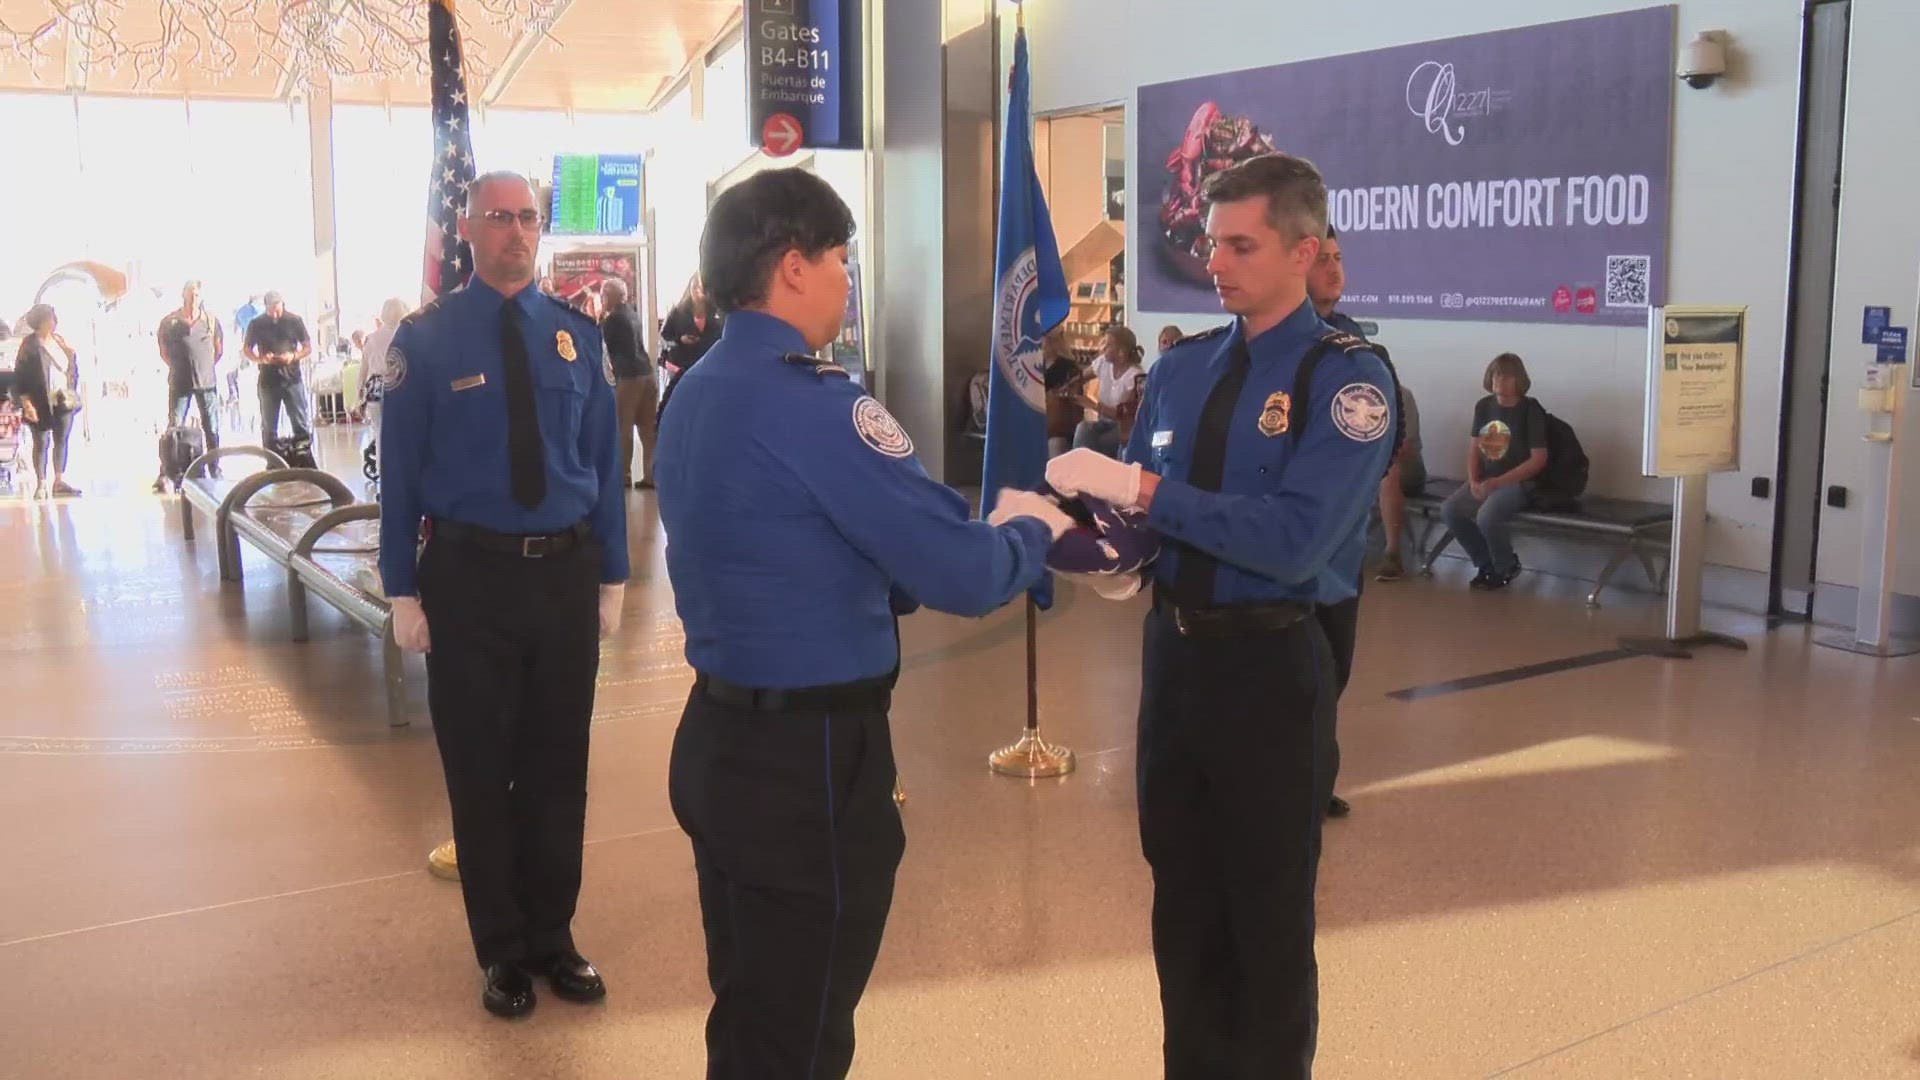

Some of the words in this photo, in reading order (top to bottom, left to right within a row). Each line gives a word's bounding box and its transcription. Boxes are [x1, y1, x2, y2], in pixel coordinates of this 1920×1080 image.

[761, 20, 820, 43] Gates
[761, 46, 829, 71] B4-B11
[761, 72, 807, 88] Puertas
[810, 76, 826, 89] de
[761, 89, 825, 104] Embarque
[1427, 177, 1561, 229] COMFORT
[1566, 174, 1649, 226] FOOD
